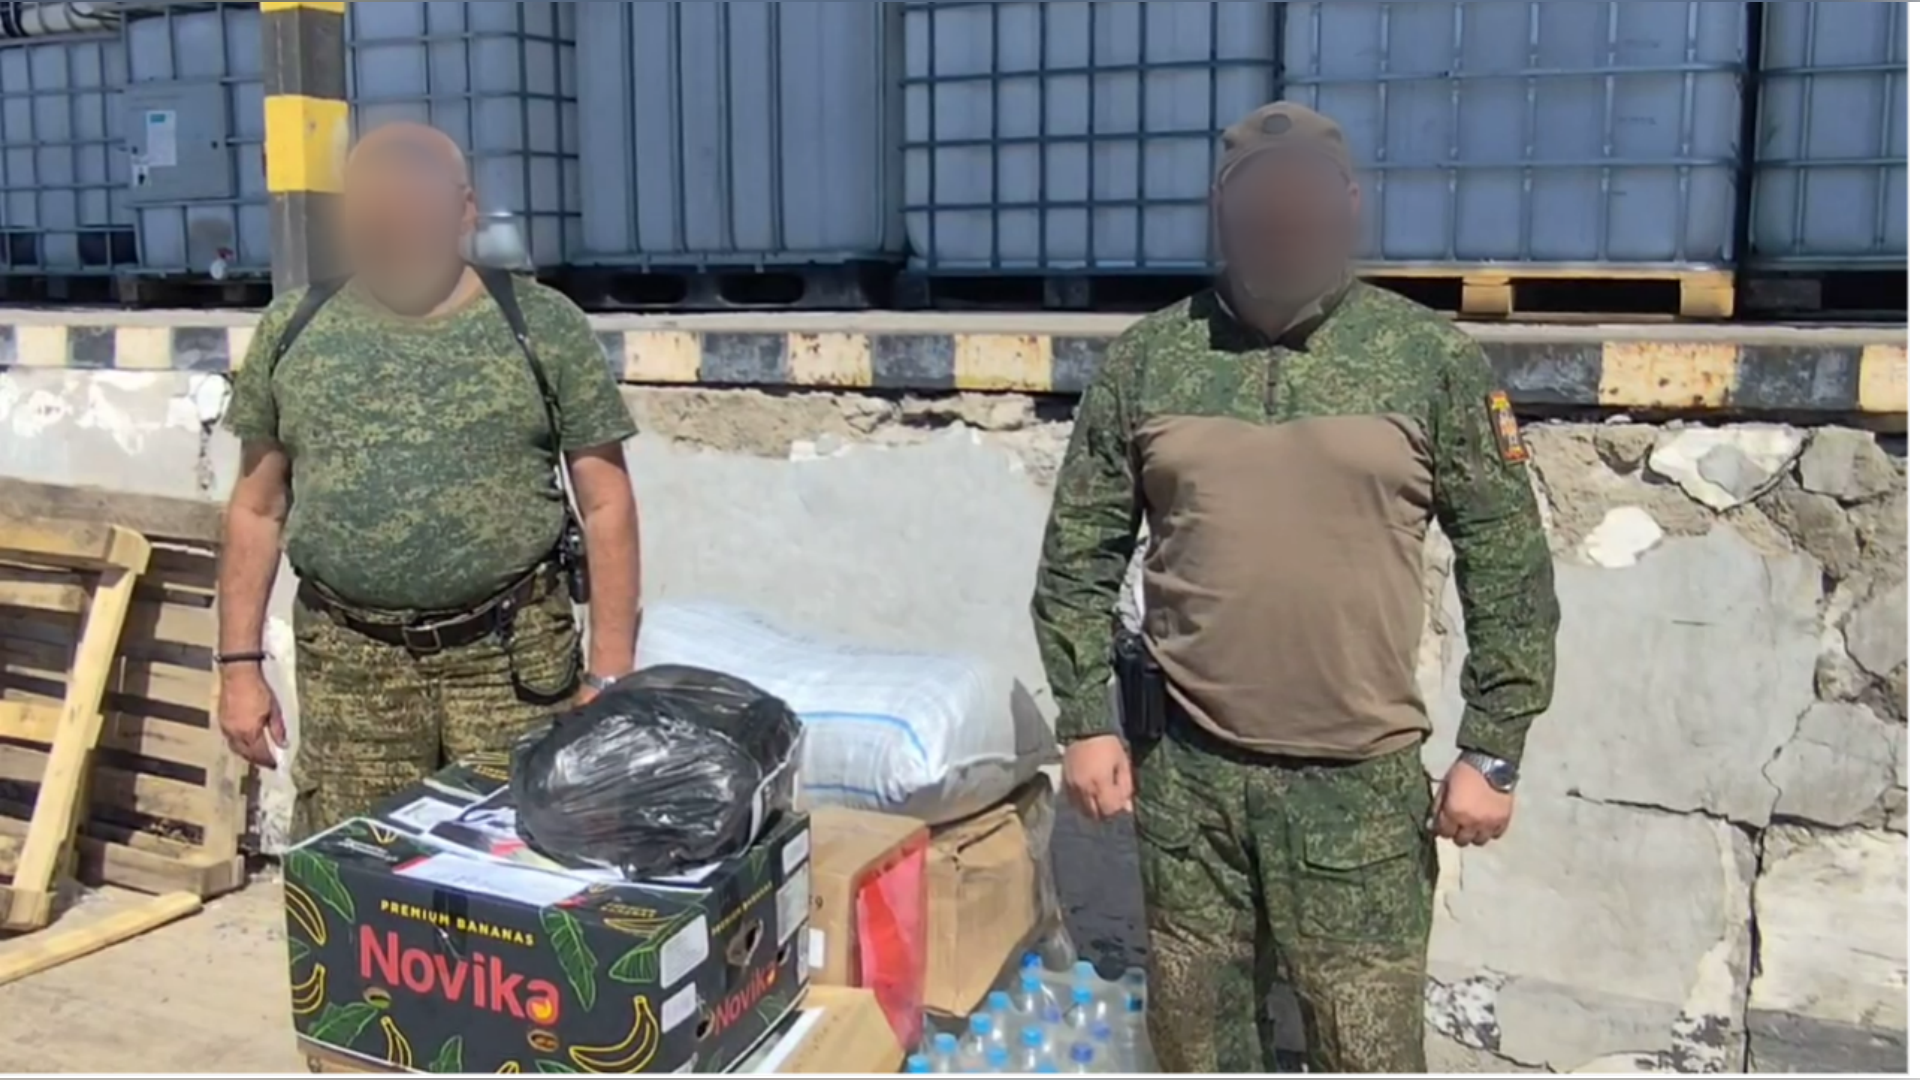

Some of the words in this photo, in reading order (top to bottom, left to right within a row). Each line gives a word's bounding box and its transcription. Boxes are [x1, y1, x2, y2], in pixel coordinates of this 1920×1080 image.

[381, 900, 449, 926] PREMIUM
[456, 917, 535, 947] BANANAS
[360, 924, 560, 1026] Novika
[714, 961, 778, 1036] Novika
